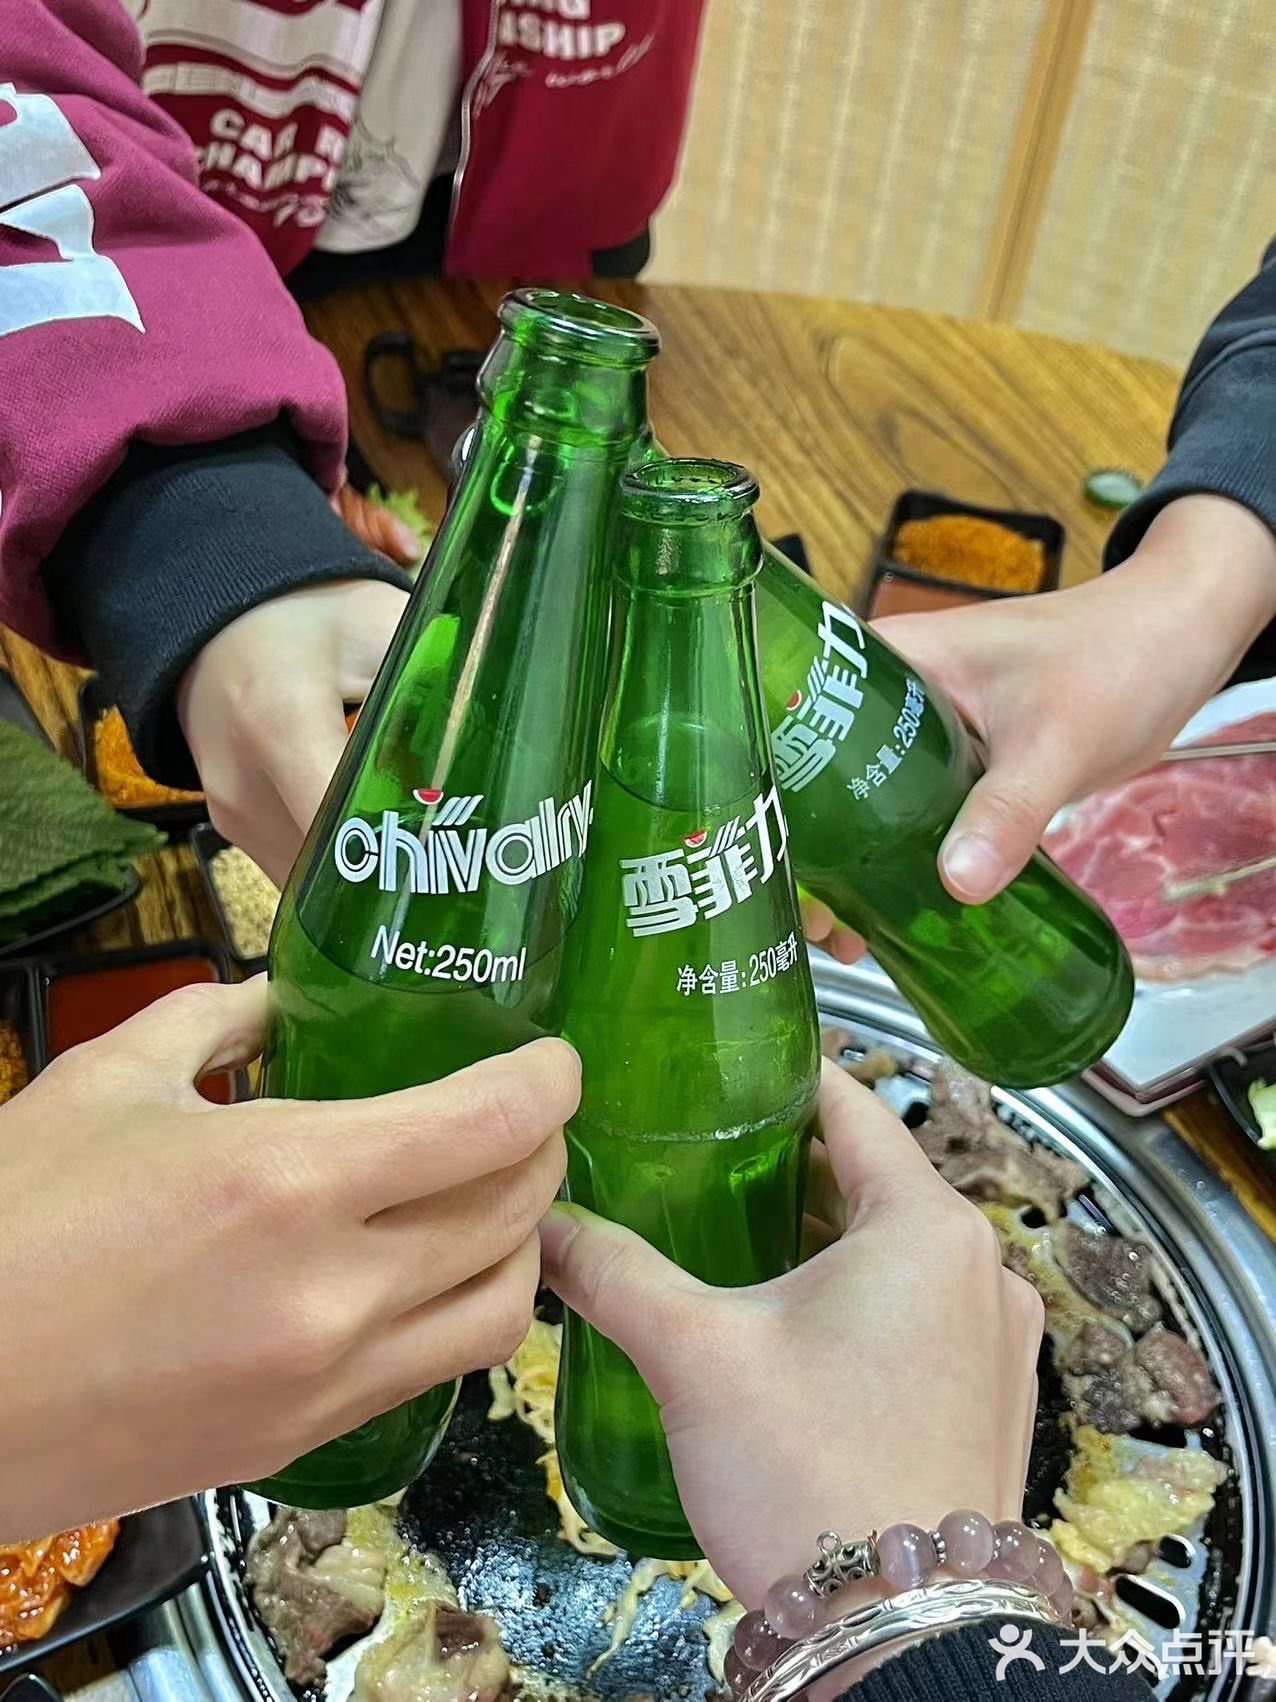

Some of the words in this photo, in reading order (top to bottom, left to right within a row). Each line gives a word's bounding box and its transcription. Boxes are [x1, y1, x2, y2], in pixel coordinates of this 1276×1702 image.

[770, 601, 868, 793] 雪菲力
[619, 784, 789, 938] 雪菲力
[371, 925, 527, 984] Net:250ml
[676, 931, 799, 996] 净含量:250毫升
